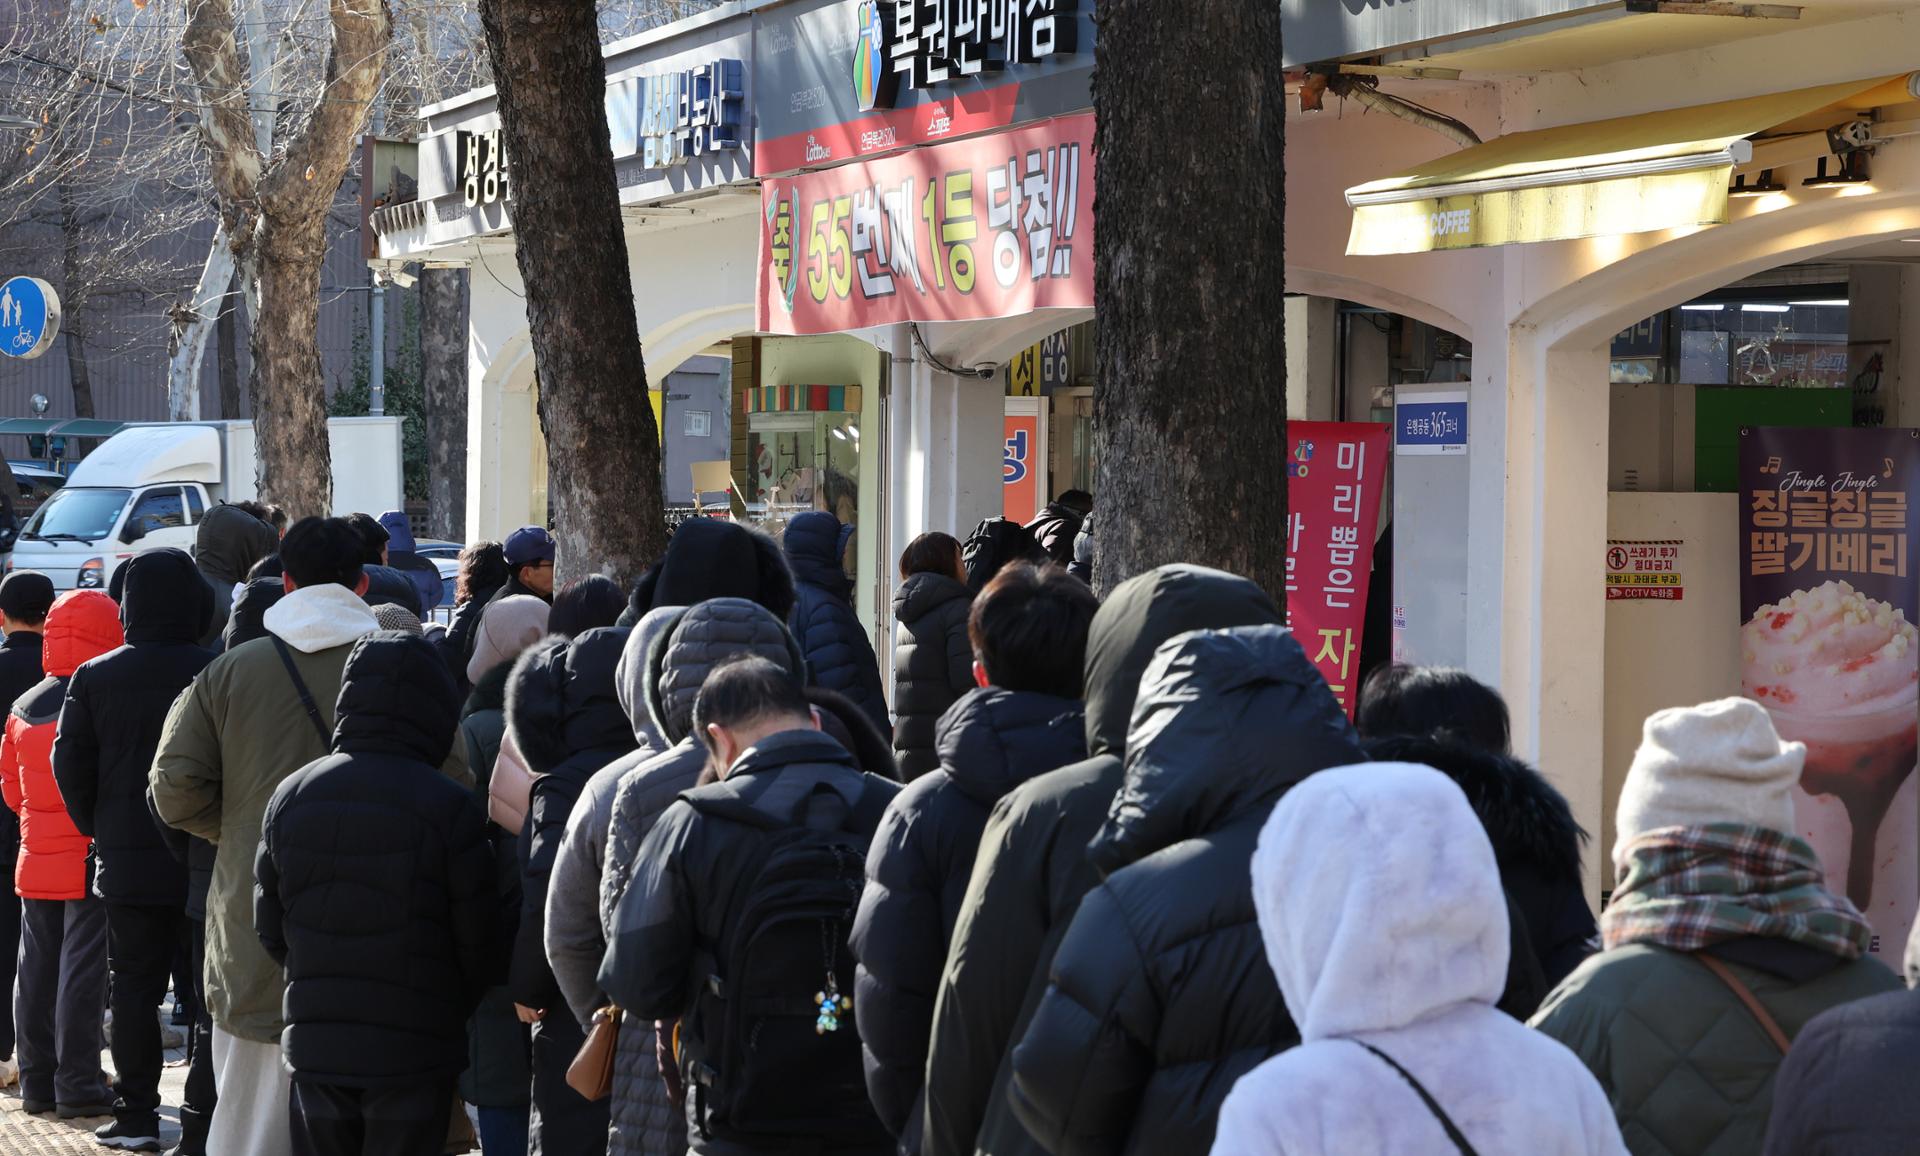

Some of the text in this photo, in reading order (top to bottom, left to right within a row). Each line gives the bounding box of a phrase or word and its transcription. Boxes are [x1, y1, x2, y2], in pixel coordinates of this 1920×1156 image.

[807, 175, 926, 304] 55번째
[921, 168, 978, 296] 1등
[986, 142, 1079, 290] 당첨!!
[1429, 208, 1471, 236] COFFEE
[1779, 471, 1879, 494] Jingle Jingle
[1751, 490, 1907, 528] 징글징글
[1629, 547, 1678, 558] 쓰레기 투기
[1634, 560, 1673, 571] 절대금지
[1751, 532, 1907, 577] 딸기베리
